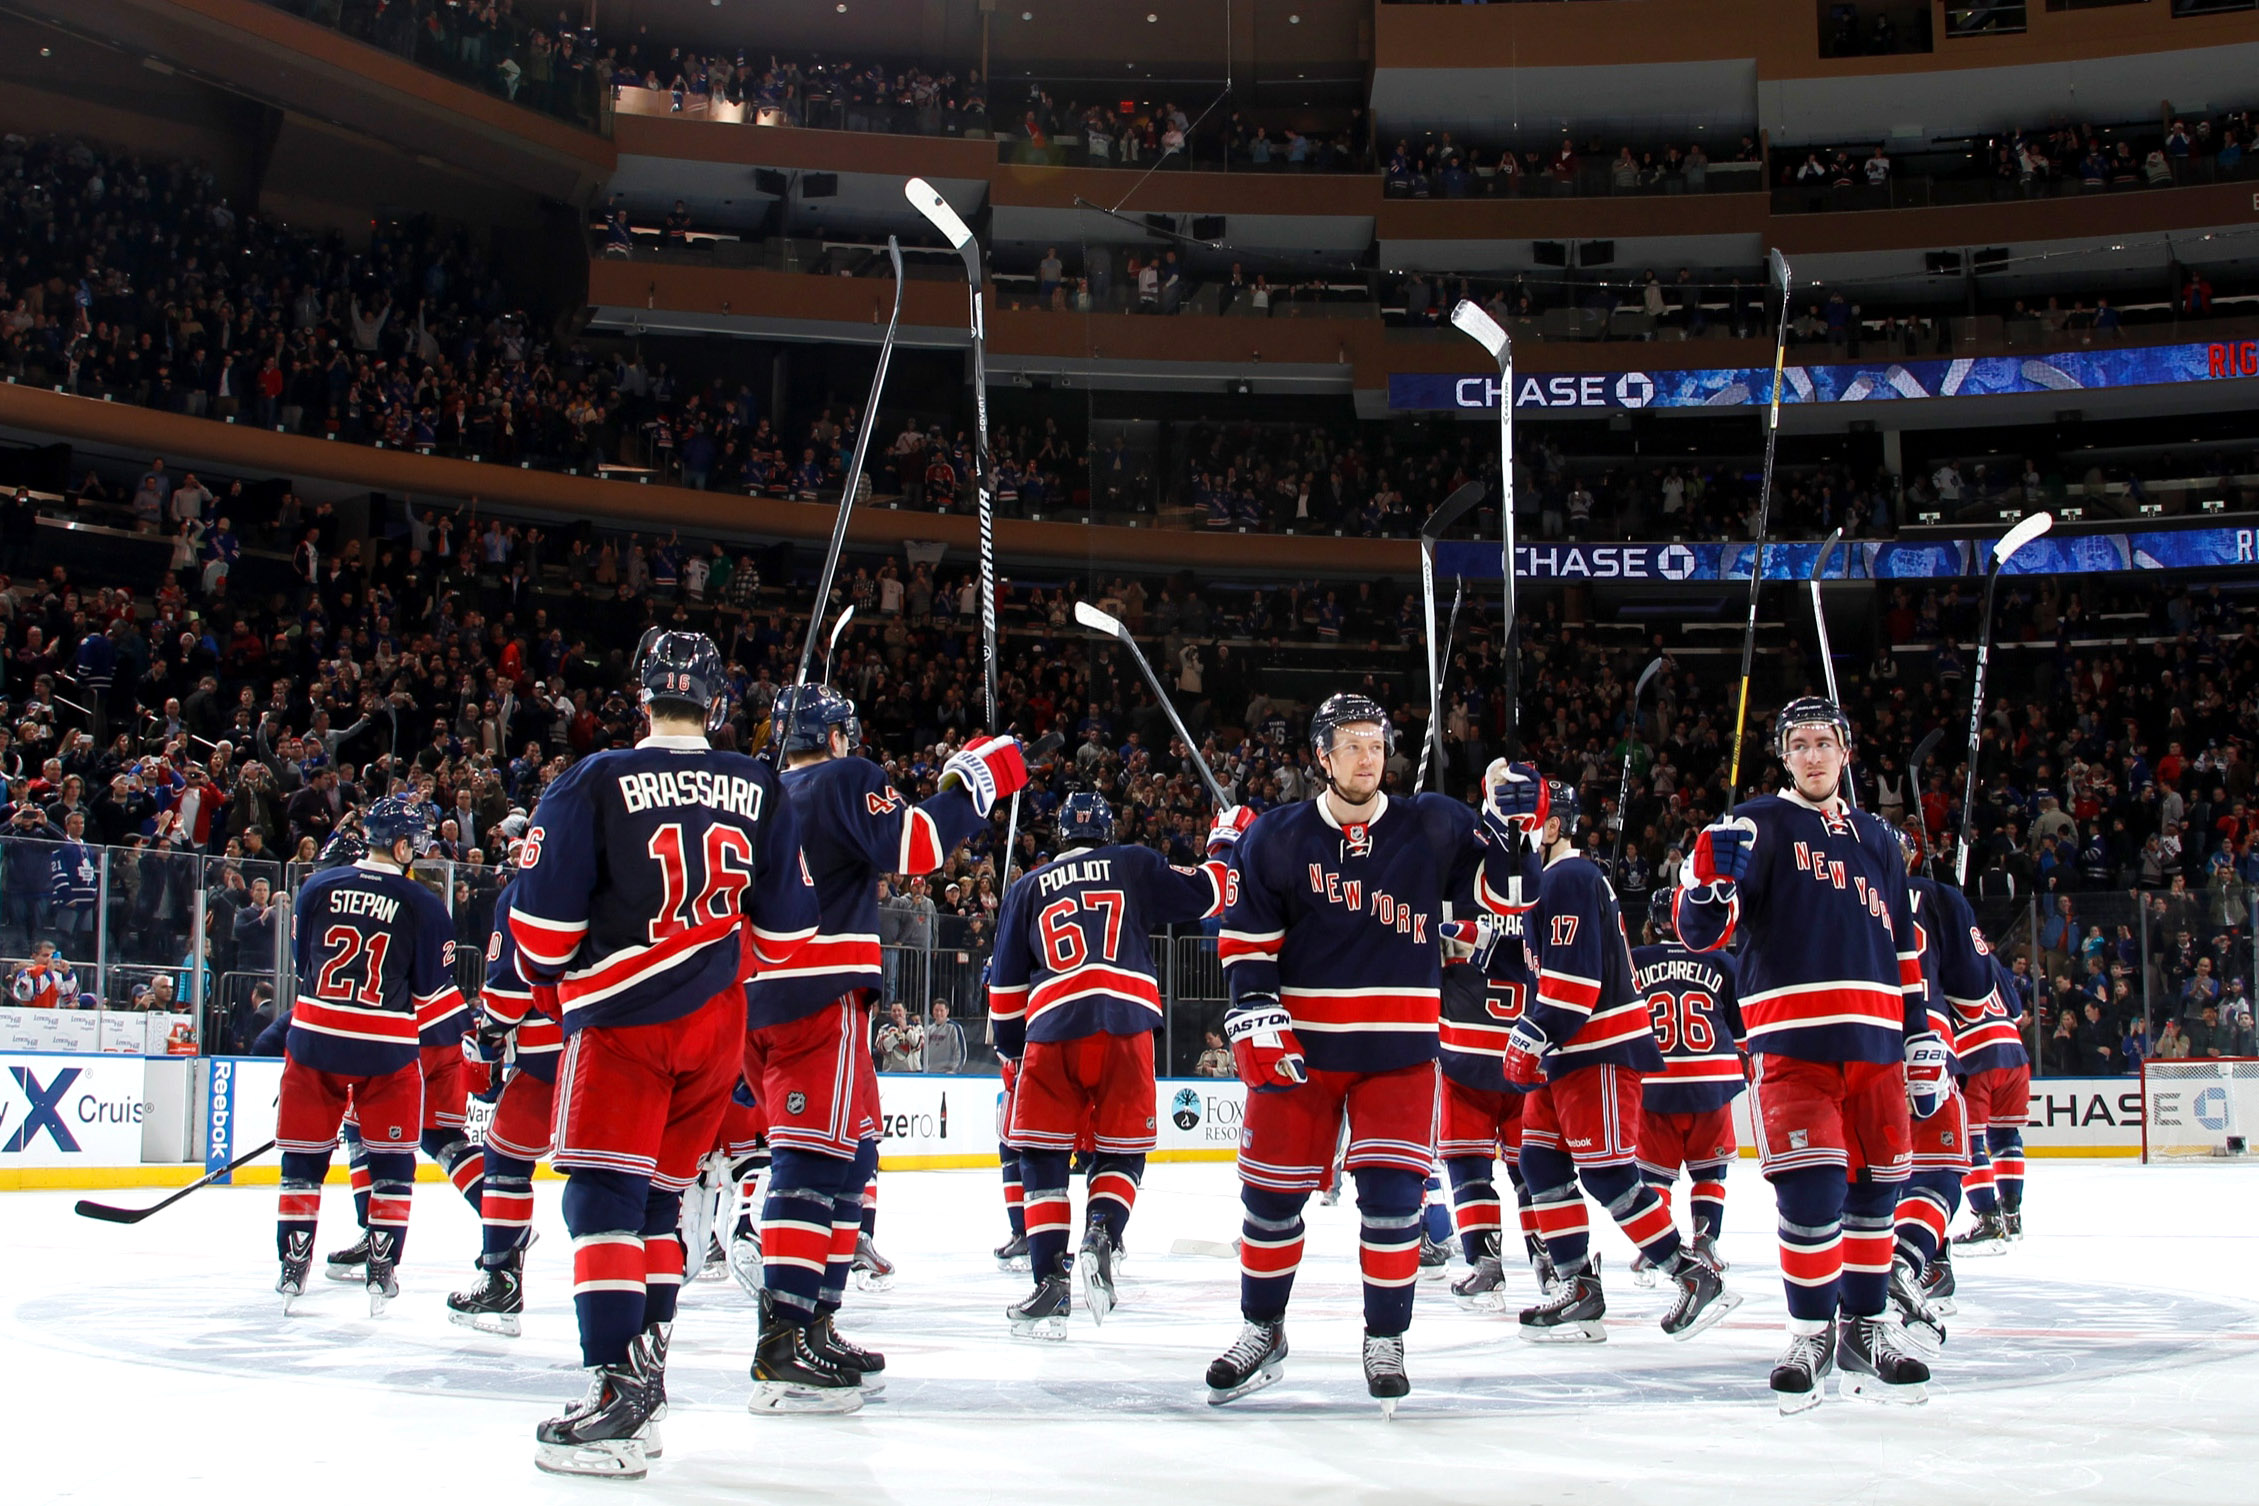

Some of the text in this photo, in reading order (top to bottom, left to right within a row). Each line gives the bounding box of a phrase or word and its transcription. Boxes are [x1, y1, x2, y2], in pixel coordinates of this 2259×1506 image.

[1456, 377, 1607, 407] CHASE
[978, 395, 986, 432] COVERT
[979, 488, 996, 633] WARRIOR
[1502, 547, 1649, 578] CHASE
[2236, 529, 2259, 562] R
[667, 672, 691, 691] 16
[618, 770, 763, 822] BRASSARD
[1077, 811, 1092, 823] 67
[648, 822, 753, 944] 16
[1038, 860, 1111, 897] POULIOT
[1794, 841, 1846, 889] NEW
[1854, 877, 1894, 942] YOR
[330, 890, 400, 924] STEPAN
[1309, 864, 1426, 944] NEW YORK
[1038, 890, 1125, 974] 67
[1550, 915, 1579, 946] 17
[316, 924, 392, 1007] 21
[1227, 1014, 1290, 1038] EASTON
[1646, 990, 1716, 1054] 36
[212, 1062, 231, 1159] Reebok
[883, 1114, 933, 1138] zero
[1206, 1127, 1241, 1141] RESO
